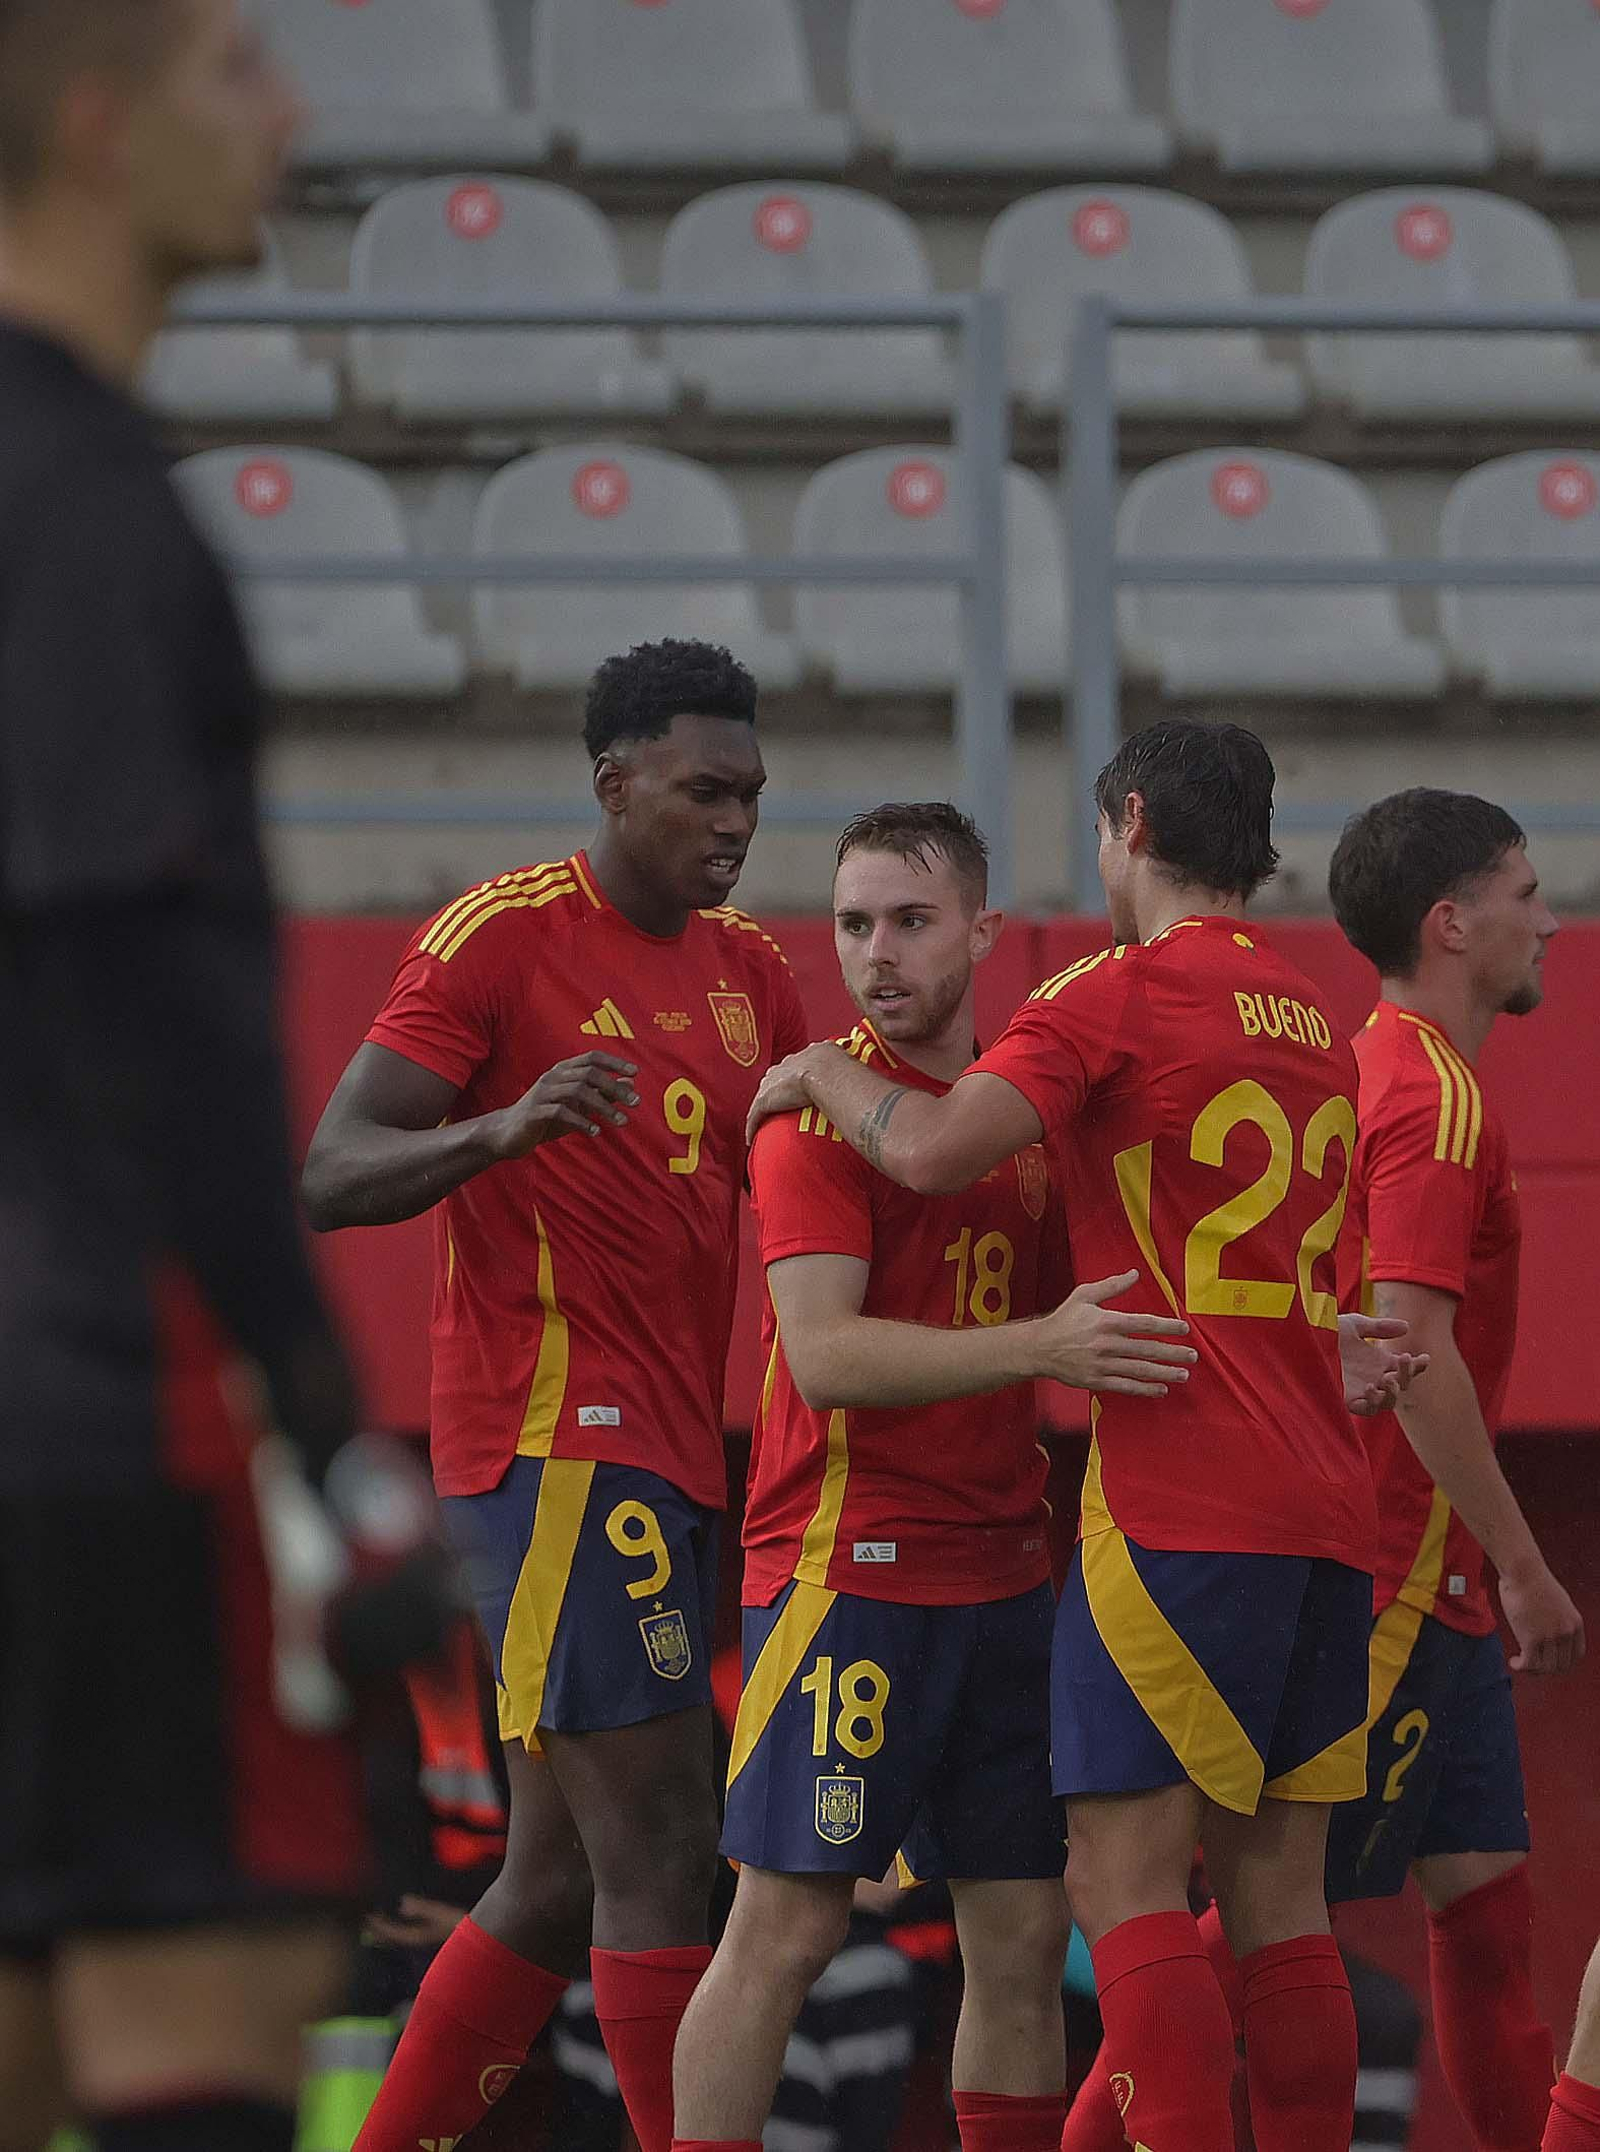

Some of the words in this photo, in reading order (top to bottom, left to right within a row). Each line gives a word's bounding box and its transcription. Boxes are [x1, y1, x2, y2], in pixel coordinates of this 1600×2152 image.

[1233, 991, 1332, 1049] BUENO
[663, 1077, 706, 1175] 9
[1185, 1079, 1357, 1332] 22
[945, 1227, 1014, 1326] 18
[605, 1499, 672, 1601] 9
[801, 1656, 891, 1760] 18
[1382, 1708, 1430, 1802] 2
